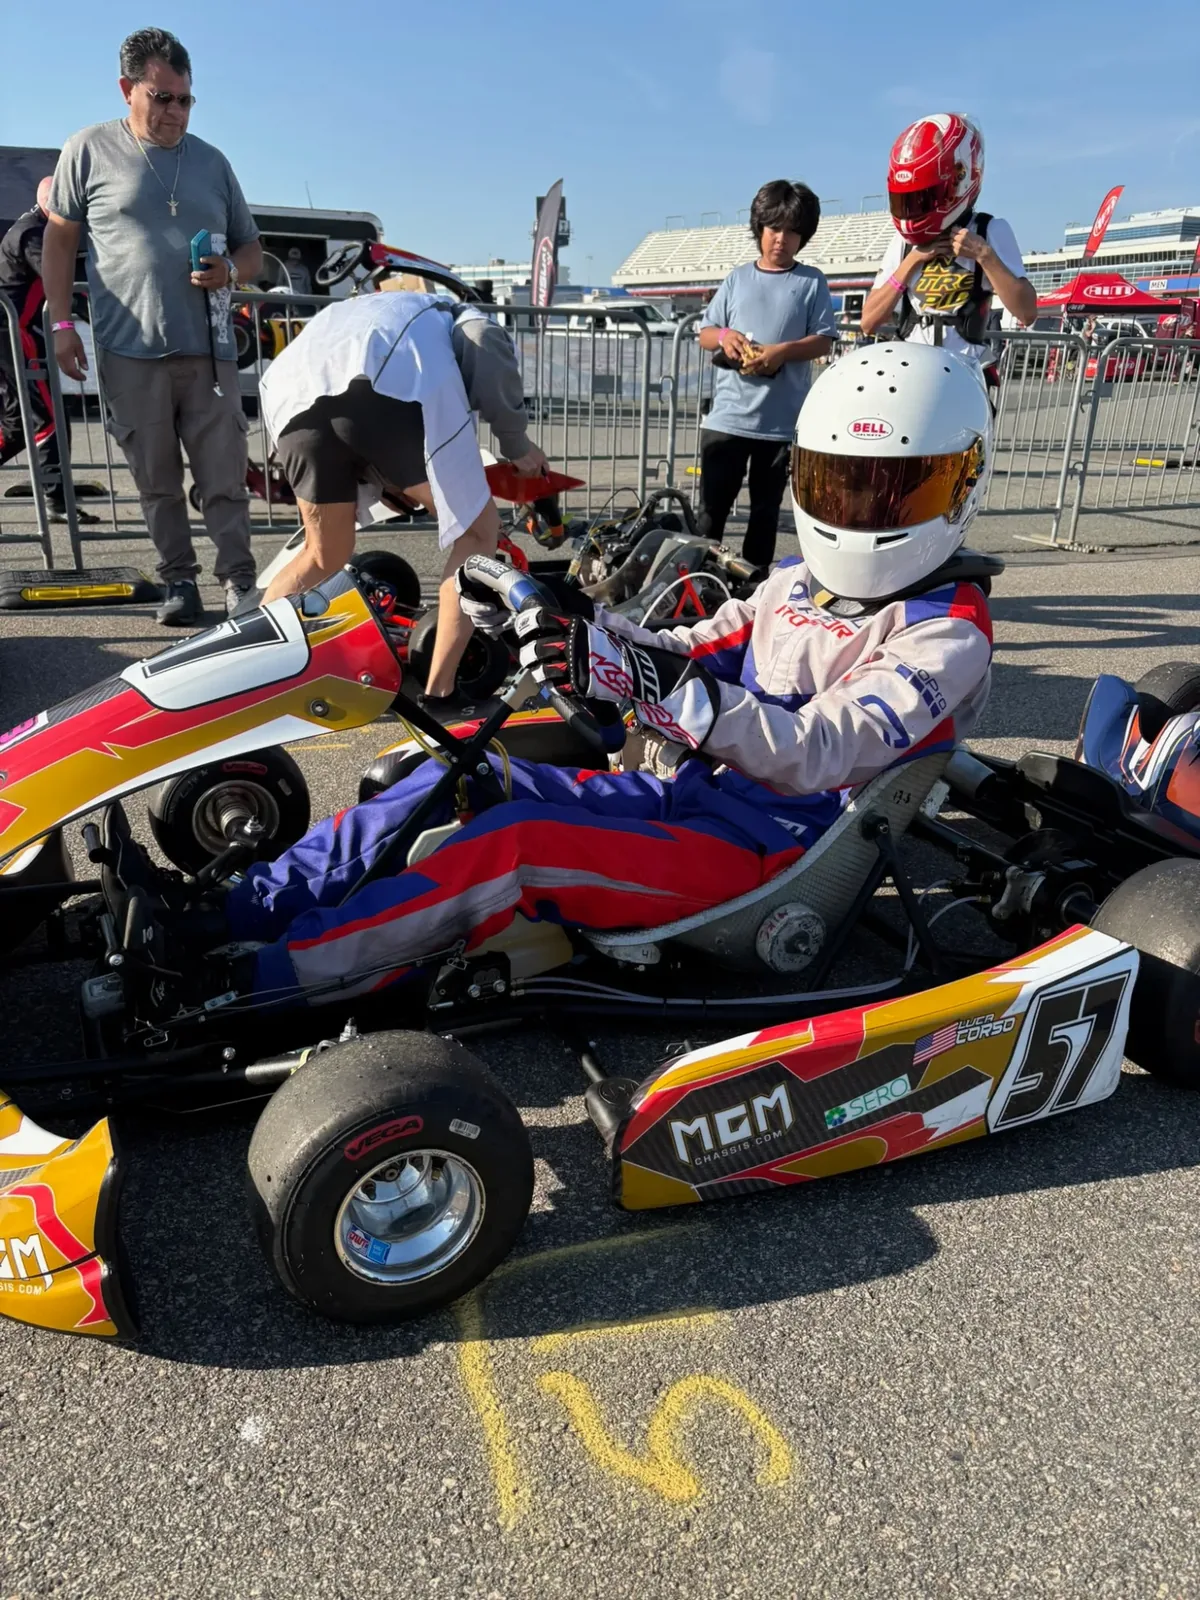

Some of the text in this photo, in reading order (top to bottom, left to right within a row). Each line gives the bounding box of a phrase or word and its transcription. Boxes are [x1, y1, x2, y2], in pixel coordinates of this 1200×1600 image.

[956, 1017, 1016, 1045] CORSO
[959, 1013, 995, 1029] LUCA
[994, 970, 1131, 1129] 57
[849, 1077, 908, 1118] SERO
[347, 1118, 419, 1154] VEGA
[670, 1082, 793, 1164] MGM
[694, 1129, 783, 1166] CHASSIS.COM
